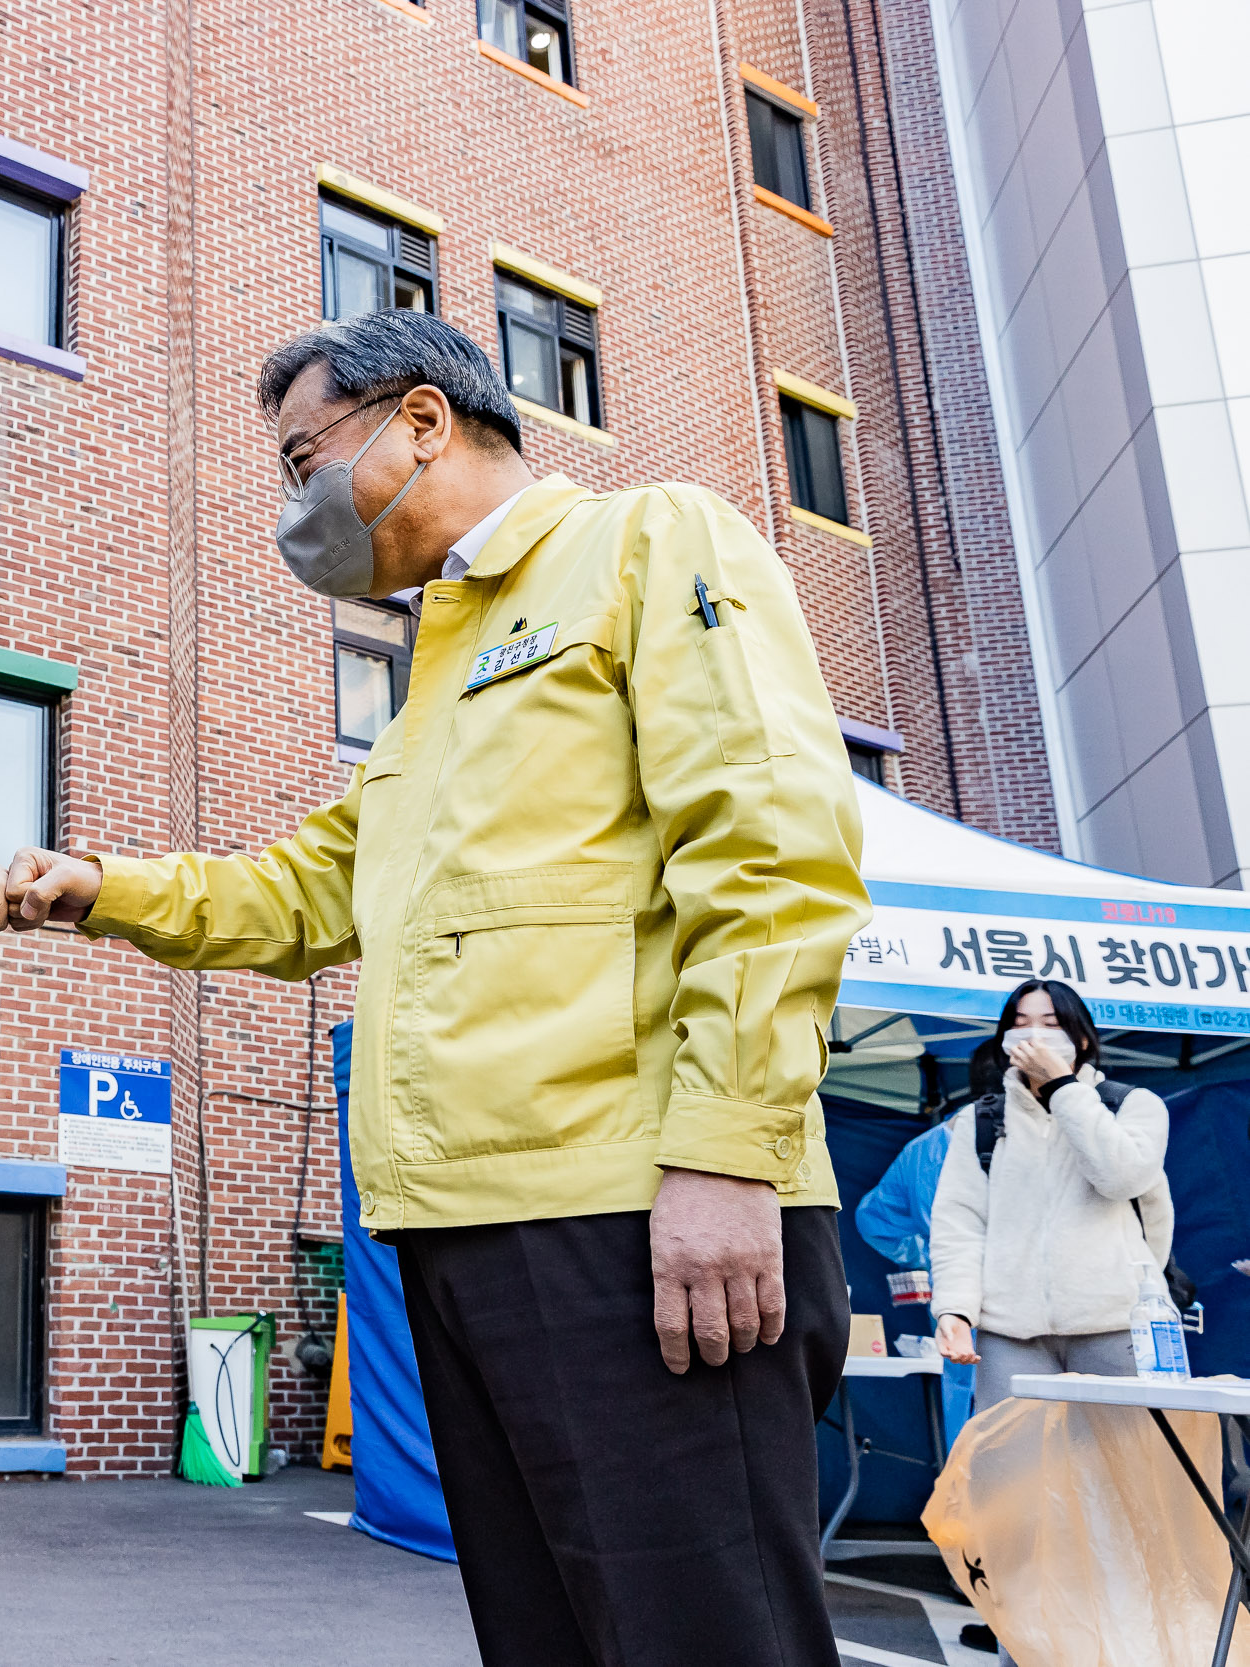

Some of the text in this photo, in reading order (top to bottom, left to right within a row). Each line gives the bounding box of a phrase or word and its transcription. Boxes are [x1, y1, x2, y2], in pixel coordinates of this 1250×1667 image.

[1101, 902, 1176, 923] 코로나19
[940, 927, 1250, 993] 서울시 찾아가
[71, 1051, 162, 1075] 장애인전용 주차구역
[88, 1070, 119, 1117] P
